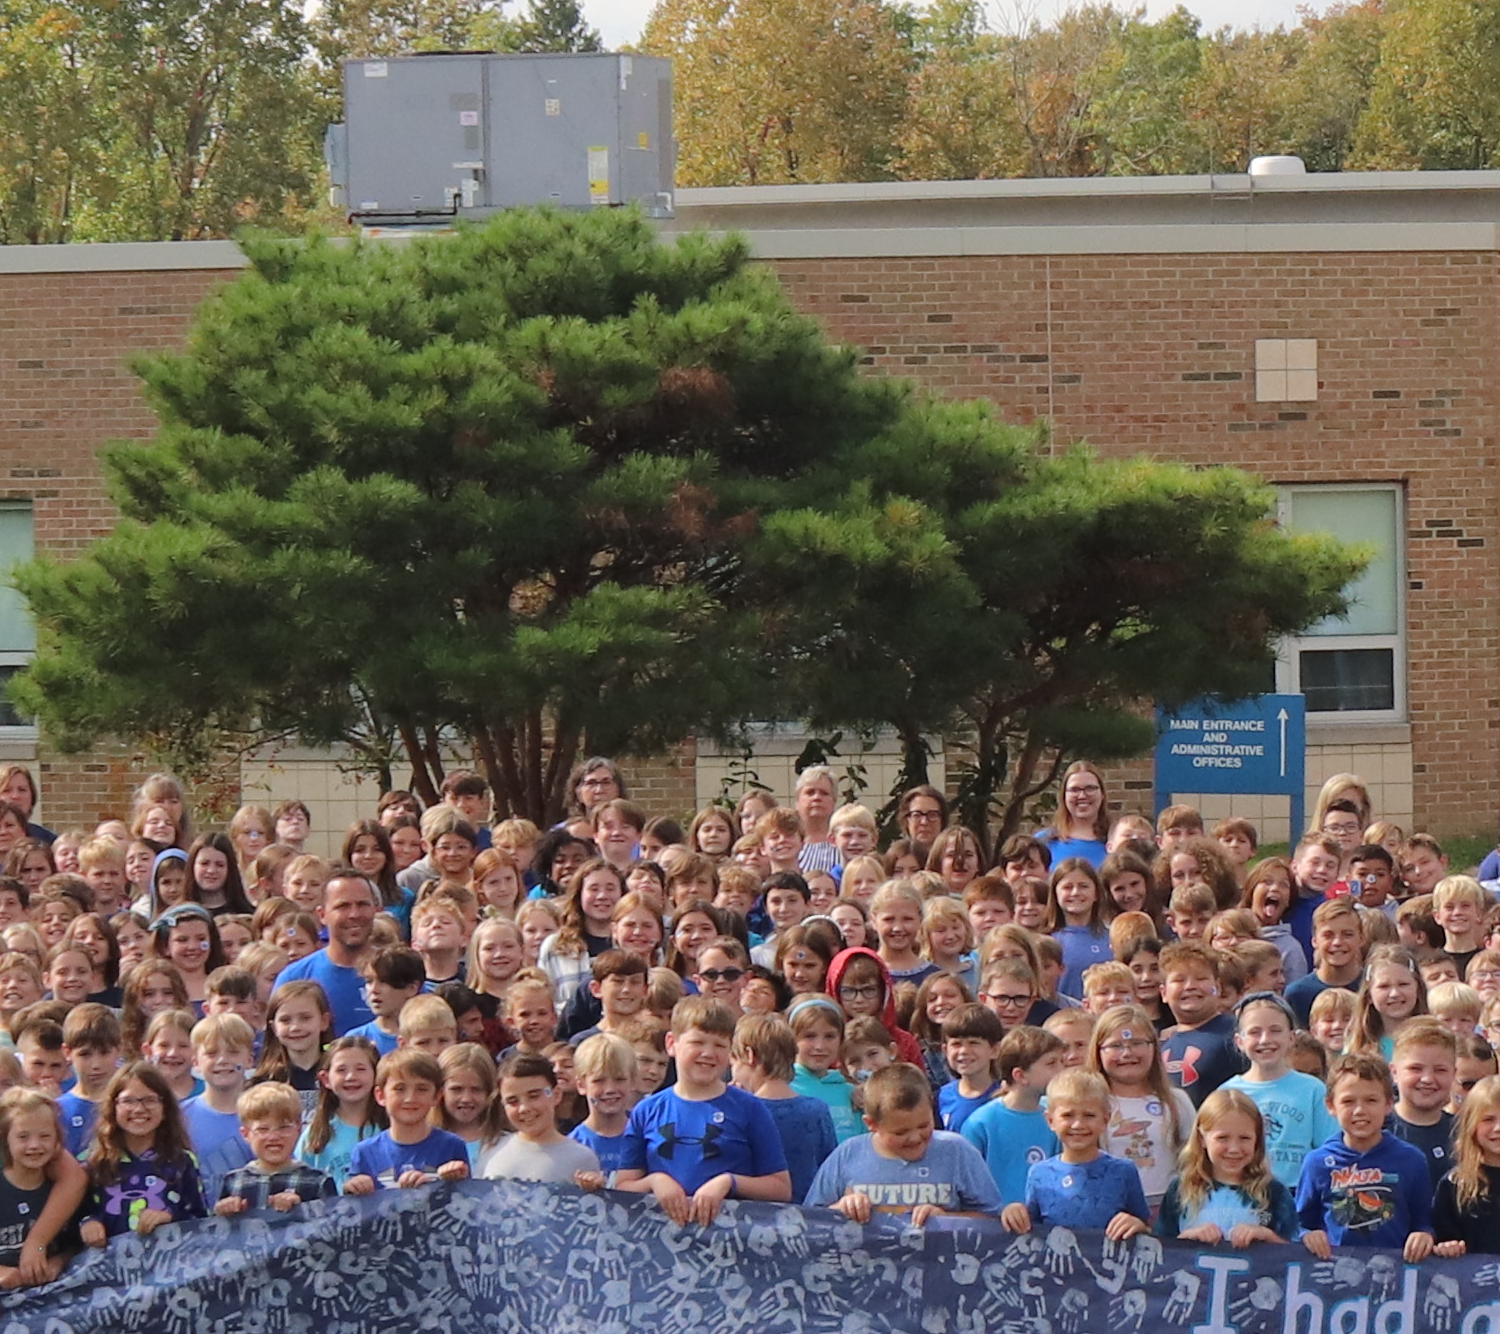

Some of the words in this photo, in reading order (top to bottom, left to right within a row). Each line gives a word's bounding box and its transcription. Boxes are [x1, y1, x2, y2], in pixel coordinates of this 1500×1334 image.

[1170, 720, 1199, 731] MAIN
[1202, 720, 1265, 732] ENTRANCE
[1203, 733, 1228, 743] AND
[1171, 744, 1264, 756] ADMINISTRATIVE
[1192, 757, 1242, 768] OFFICES
[1330, 1163, 1382, 1188] NINJA
